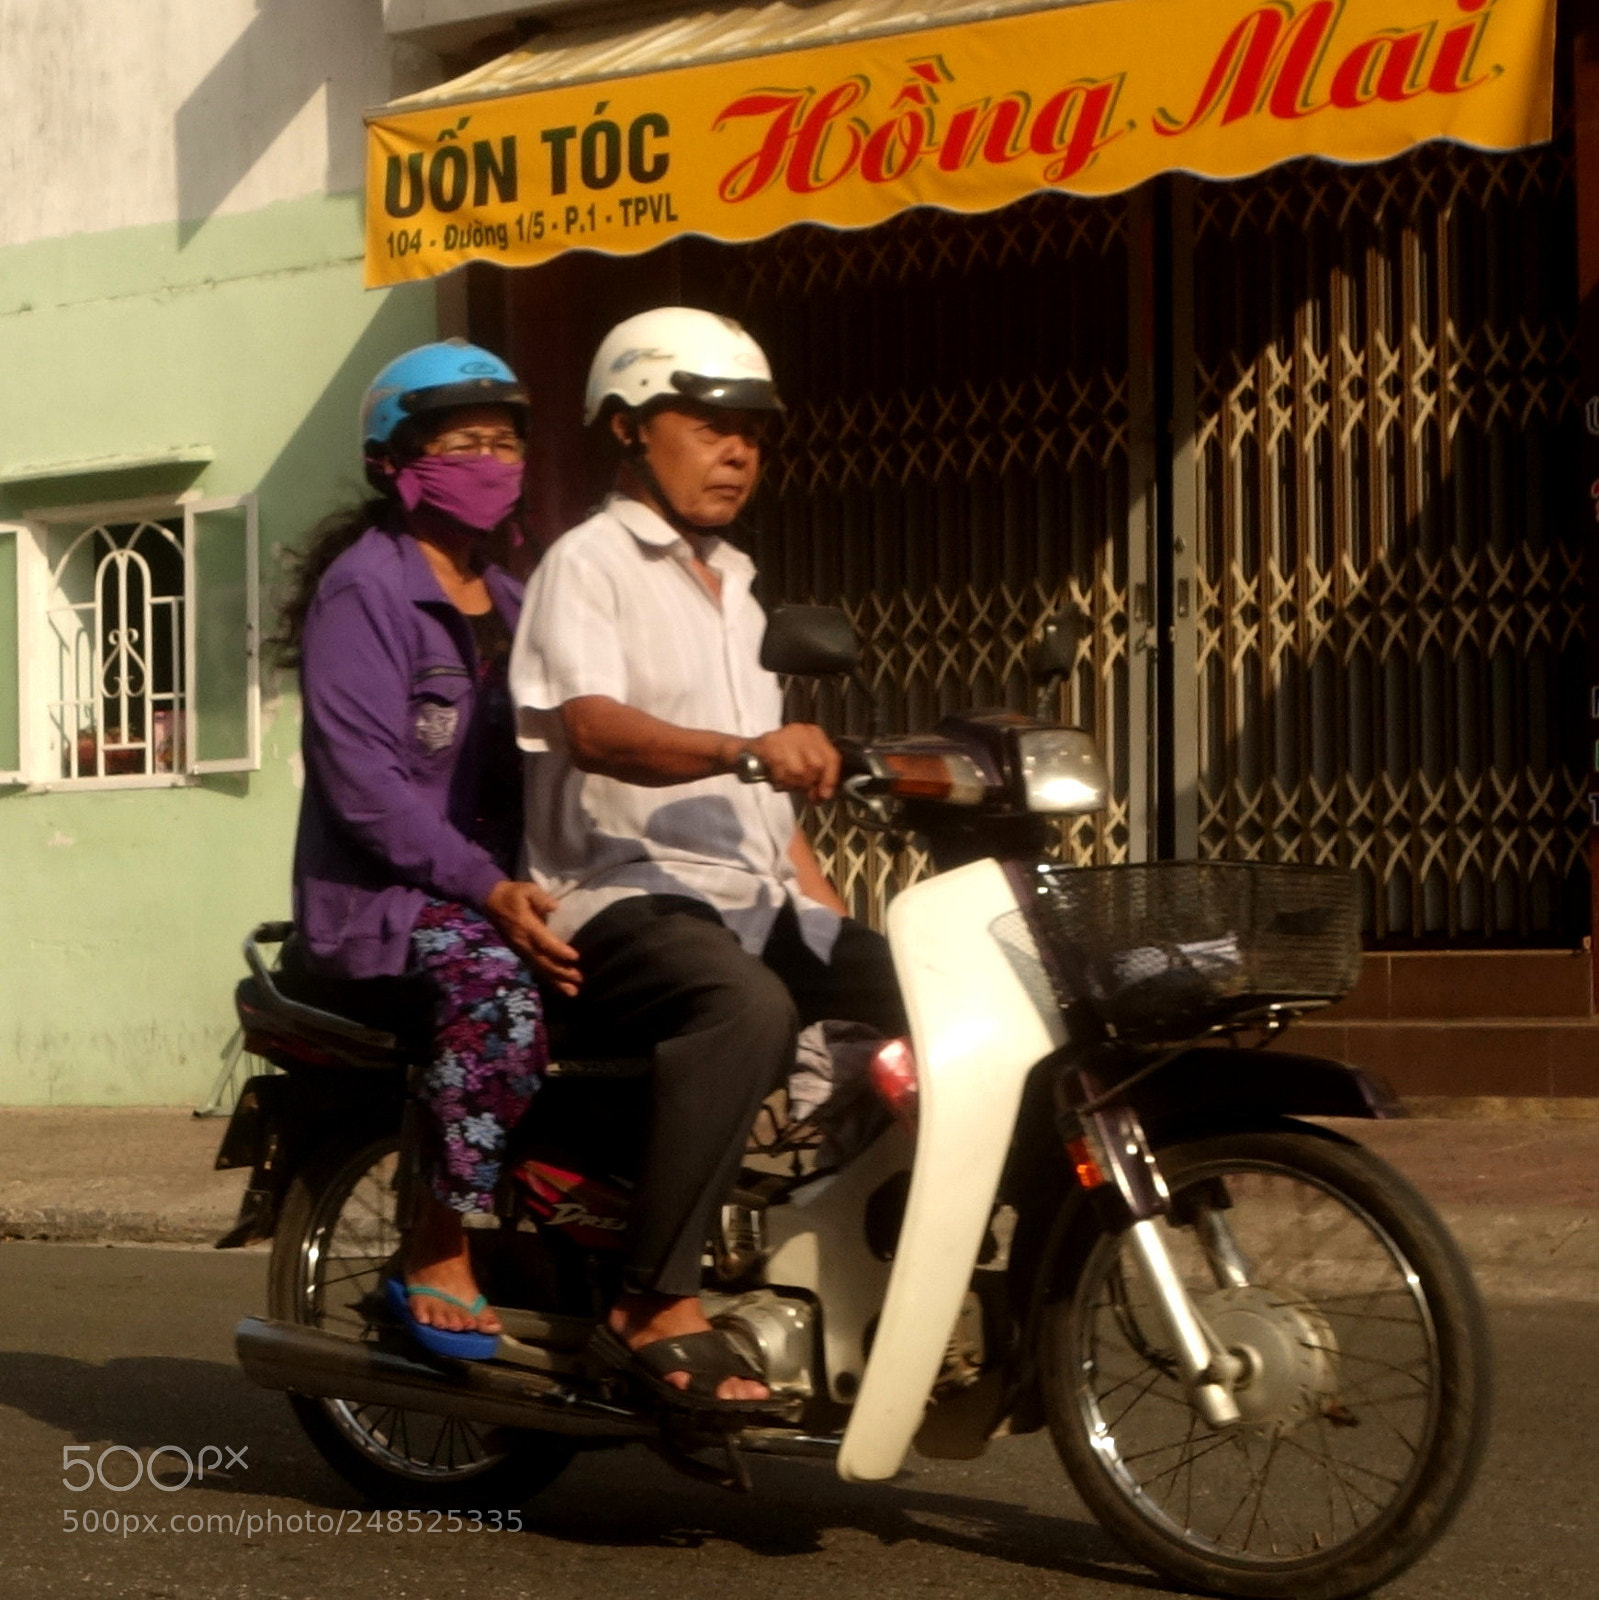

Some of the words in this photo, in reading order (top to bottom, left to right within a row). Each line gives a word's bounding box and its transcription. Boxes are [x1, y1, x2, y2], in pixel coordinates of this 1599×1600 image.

[385, 116, 518, 218] UỐN
[541, 101, 670, 196] TÓC
[711, 56, 1132, 203] Hồng
[1152, 0, 1502, 136] Mai
[387, 228, 422, 258] 104
[444, 219, 509, 251] Đường
[515, 209, 545, 243] 1/5
[565, 203, 596, 234] P.1
[619, 193, 678, 227] TPVL
